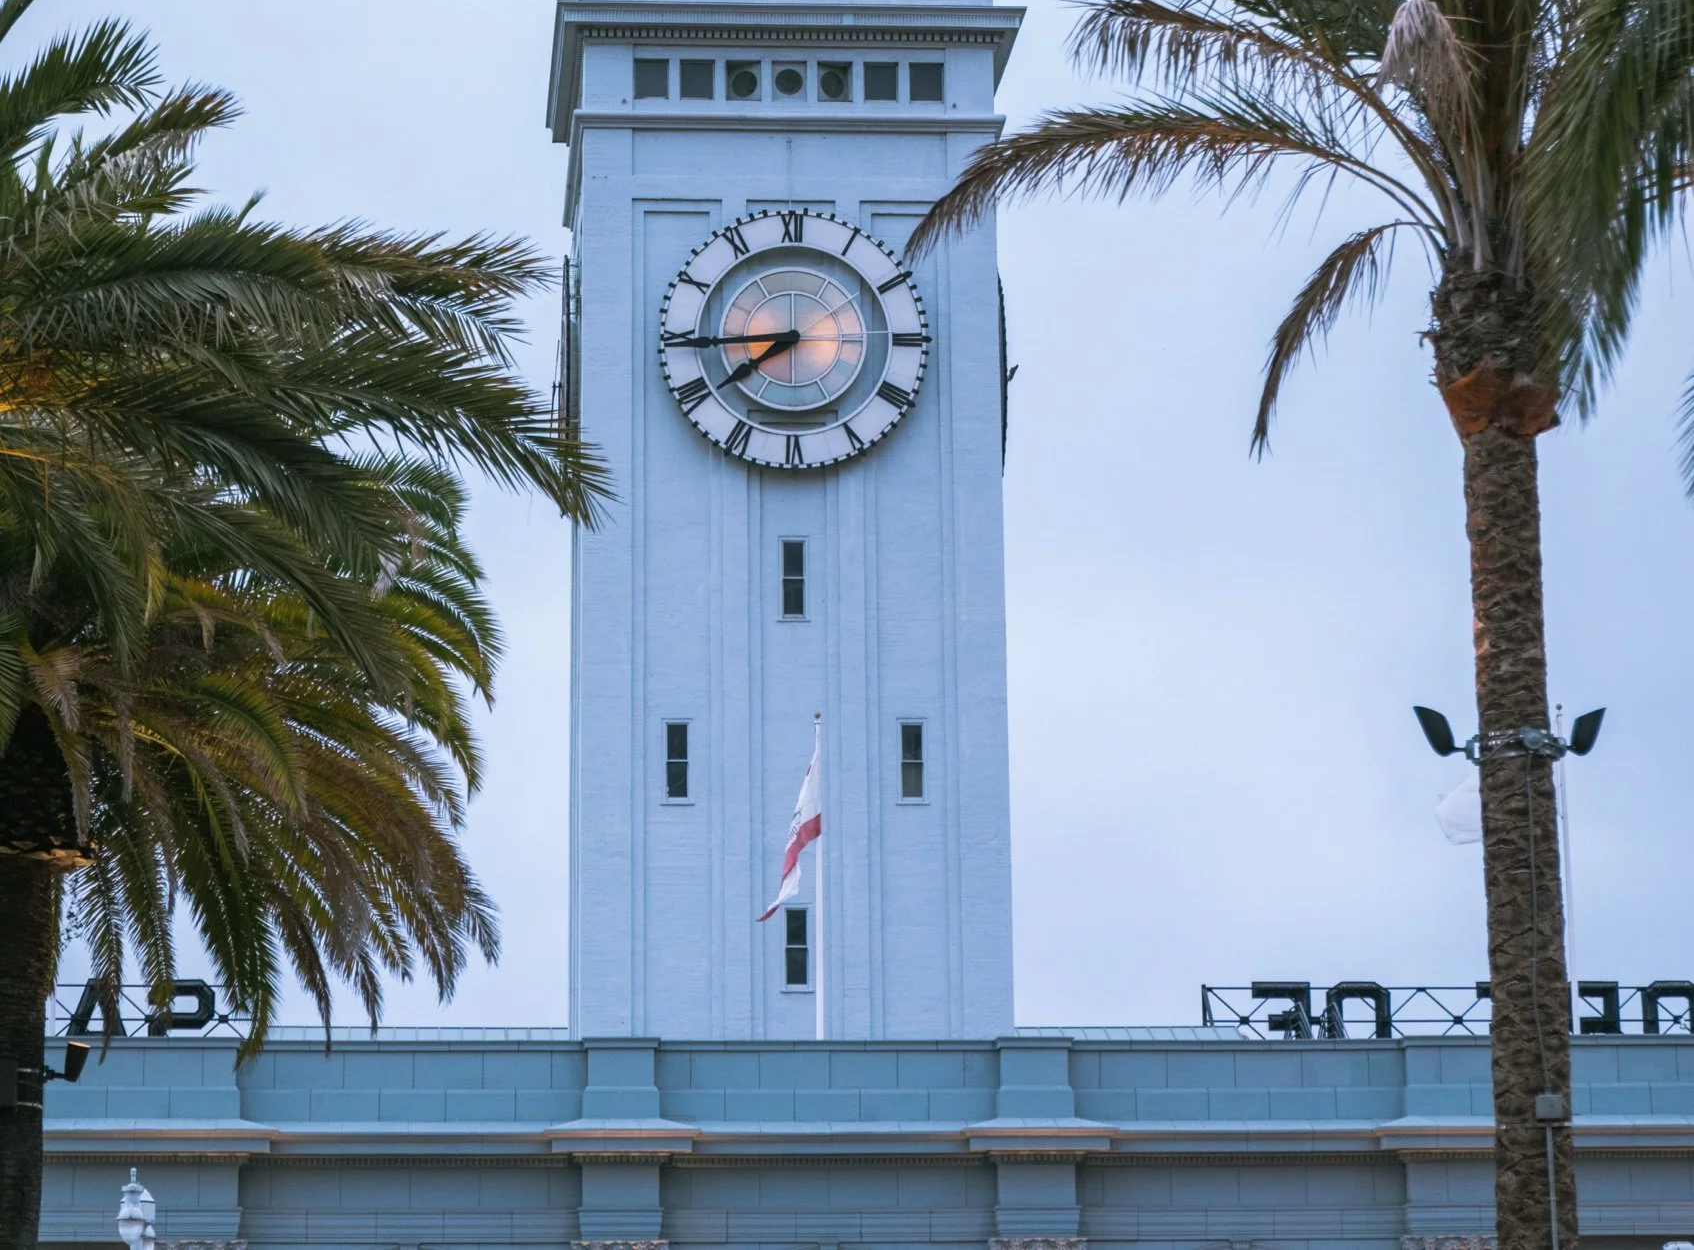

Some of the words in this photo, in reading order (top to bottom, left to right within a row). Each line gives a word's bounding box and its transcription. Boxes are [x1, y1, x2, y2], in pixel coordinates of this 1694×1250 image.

[780, 213, 803, 243] XII
[722, 227, 750, 260] XI
[841, 229, 860, 256] I
[679, 272, 711, 295] X
[876, 273, 906, 294] II
[664, 329, 696, 347] X
[892, 333, 923, 347] III
[674, 377, 712, 415] VIII
[723, 419, 753, 457] VII
[785, 434, 804, 464] VI
[843, 423, 865, 451] V
